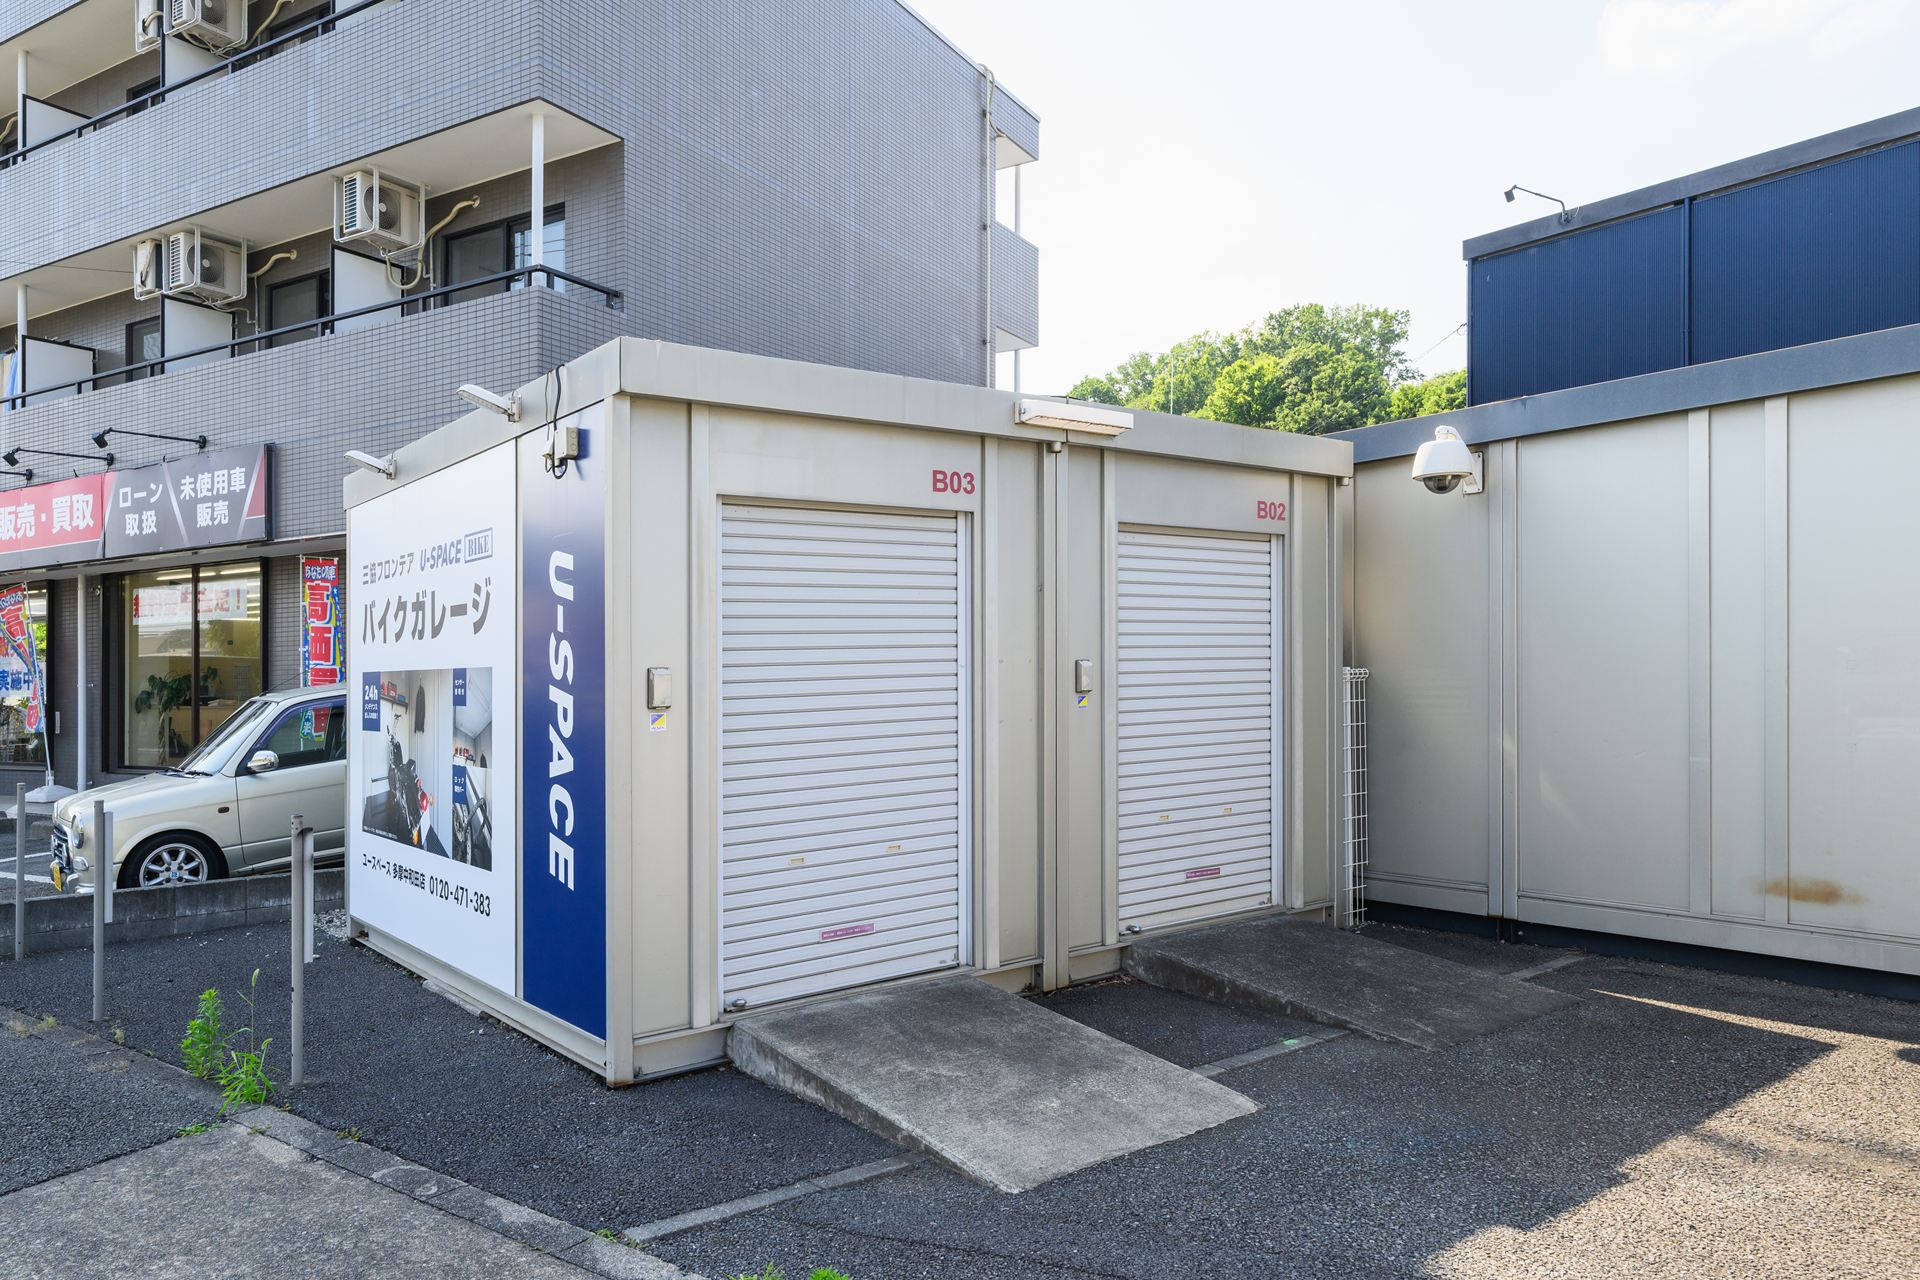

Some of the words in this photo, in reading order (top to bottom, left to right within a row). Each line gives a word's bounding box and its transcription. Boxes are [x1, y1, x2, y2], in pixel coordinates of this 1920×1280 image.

[119, 483, 163, 508] ローン
[180, 466, 246, 501] 未使用車
[932, 469, 976, 495] B03
[125, 510, 157, 537] 取扱
[196, 500, 229, 528] 販売
[1256, 500, 1286, 521] B02
[420, 538, 462, 572] U-SPACE
[468, 533, 490, 558] BIKE
[362, 576, 492, 646] バイクガレージ
[364, 685, 379, 701] 24h
[549, 549, 574, 892] U-SPACE
[362, 853, 392, 876] ユースペース
[429, 875, 491, 918] 0120-471-383
